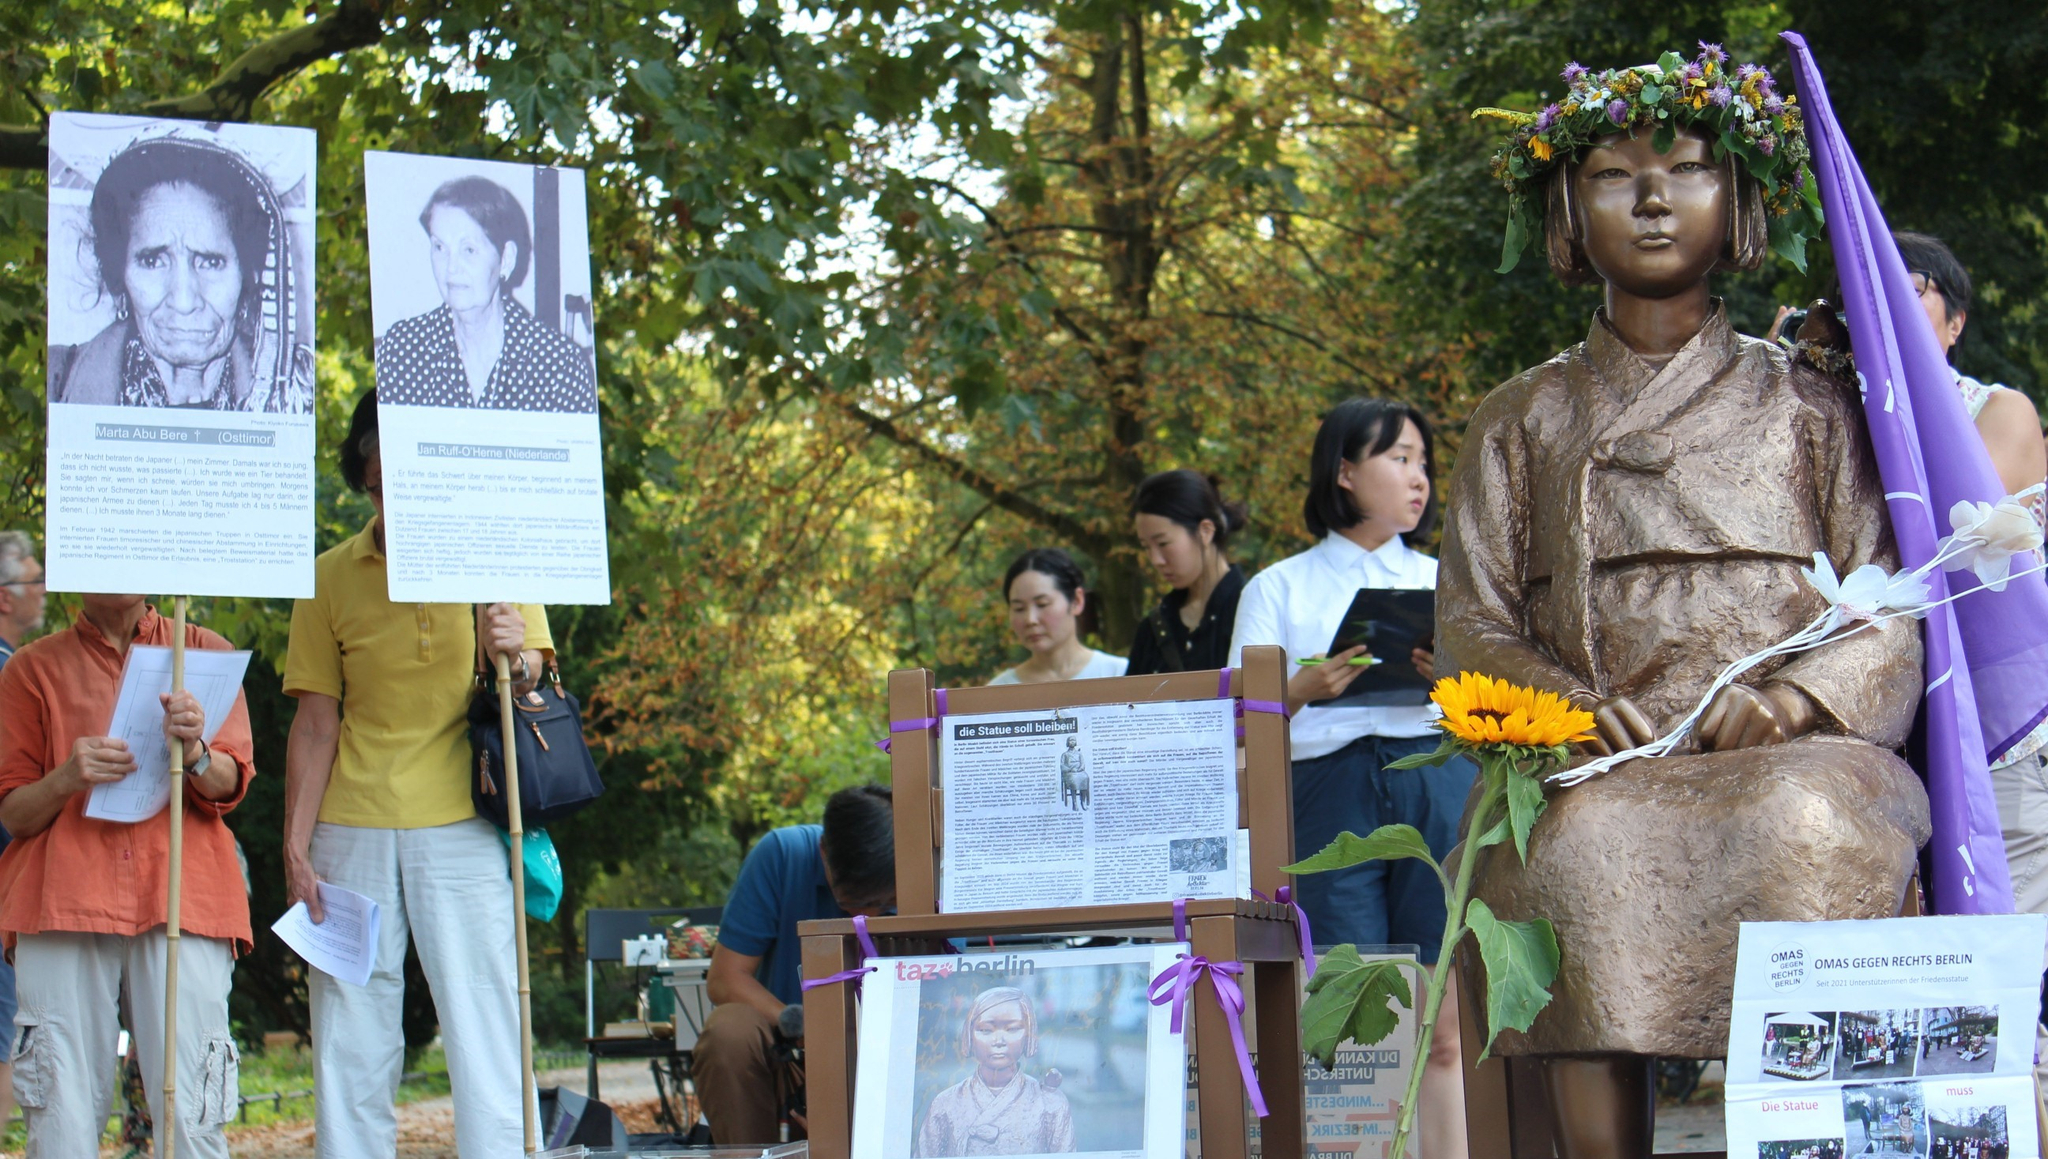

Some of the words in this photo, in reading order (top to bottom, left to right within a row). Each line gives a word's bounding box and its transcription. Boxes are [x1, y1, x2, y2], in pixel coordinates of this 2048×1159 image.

[96, 426, 129, 438] Marta
[133, 428, 156, 440] Abu
[160, 430, 188, 441] Bere
[218, 431, 276, 447] (Osttimor)
[71, 452, 83, 461] der
[84, 452, 105, 461] Nacht
[105, 454, 133, 463] betraten
[134, 455, 145, 463] die
[146, 456, 173, 465] Japaner
[232, 459, 258, 468] Damals
[418, 444, 436, 456] Jan
[505, 447, 570, 462] (Niederlande)
[60, 463, 77, 471] dass
[152, 467, 183, 475] passierte
[260, 470, 273, 478] Tier
[60, 473, 72, 482] Sie
[75, 475, 98, 484] sagten
[181, 479, 205, 487] würden
[280, 481, 309, 492] Morgens
[60, 484, 83, 492] konnte
[85, 485, 95, 493] ich
[111, 486, 148, 495] Schmerzen
[150, 487, 169, 496] kaum
[196, 489, 220, 498] Unsere
[222, 490, 249, 500] Aufgabe
[251, 491, 262, 501] lag
[60, 495, 100, 504] japanischen
[102, 496, 124, 505] Armee
[137, 498, 160, 506] dienen
[178, 499, 199, 508] Jeden
[201, 499, 214, 510] Tag
[260, 502, 271, 510] bis
[272, 502, 278, 510] 5
[99, 507, 110, 515] Ich
[136, 508, 155, 516] ihnen
[156, 508, 161, 517] 3
[162, 509, 187, 518] Monate
[188, 510, 203, 520] lang
[959, 726, 975, 737] die
[978, 725, 1011, 735] Statue
[1014, 723, 1033, 734] soll
[1035, 720, 1076, 732] bleiben!
[1770, 949, 1804, 963] OMAS
[1814, 958, 1849, 969] OMAS
[1852, 957, 1889, 968] GEGEN
[1892, 955, 1932, 966] RECHTS
[1936, 954, 1973, 965] BERLIN
[896, 960, 937, 982] taz
[956, 955, 1035, 976] berlin
[1780, 960, 1804, 970] GEGEN
[1771, 968, 1804, 980] RECHTS
[1850, 977, 1908, 986] Unterstützerinnen
[1921, 975, 1969, 983] Friedensstatue
[1775, 978, 1801, 988] BERLIN
[1946, 1086, 1974, 1096] muss
[1761, 1101, 1780, 1112] Die
[1783, 1100, 1819, 1111] Statue
